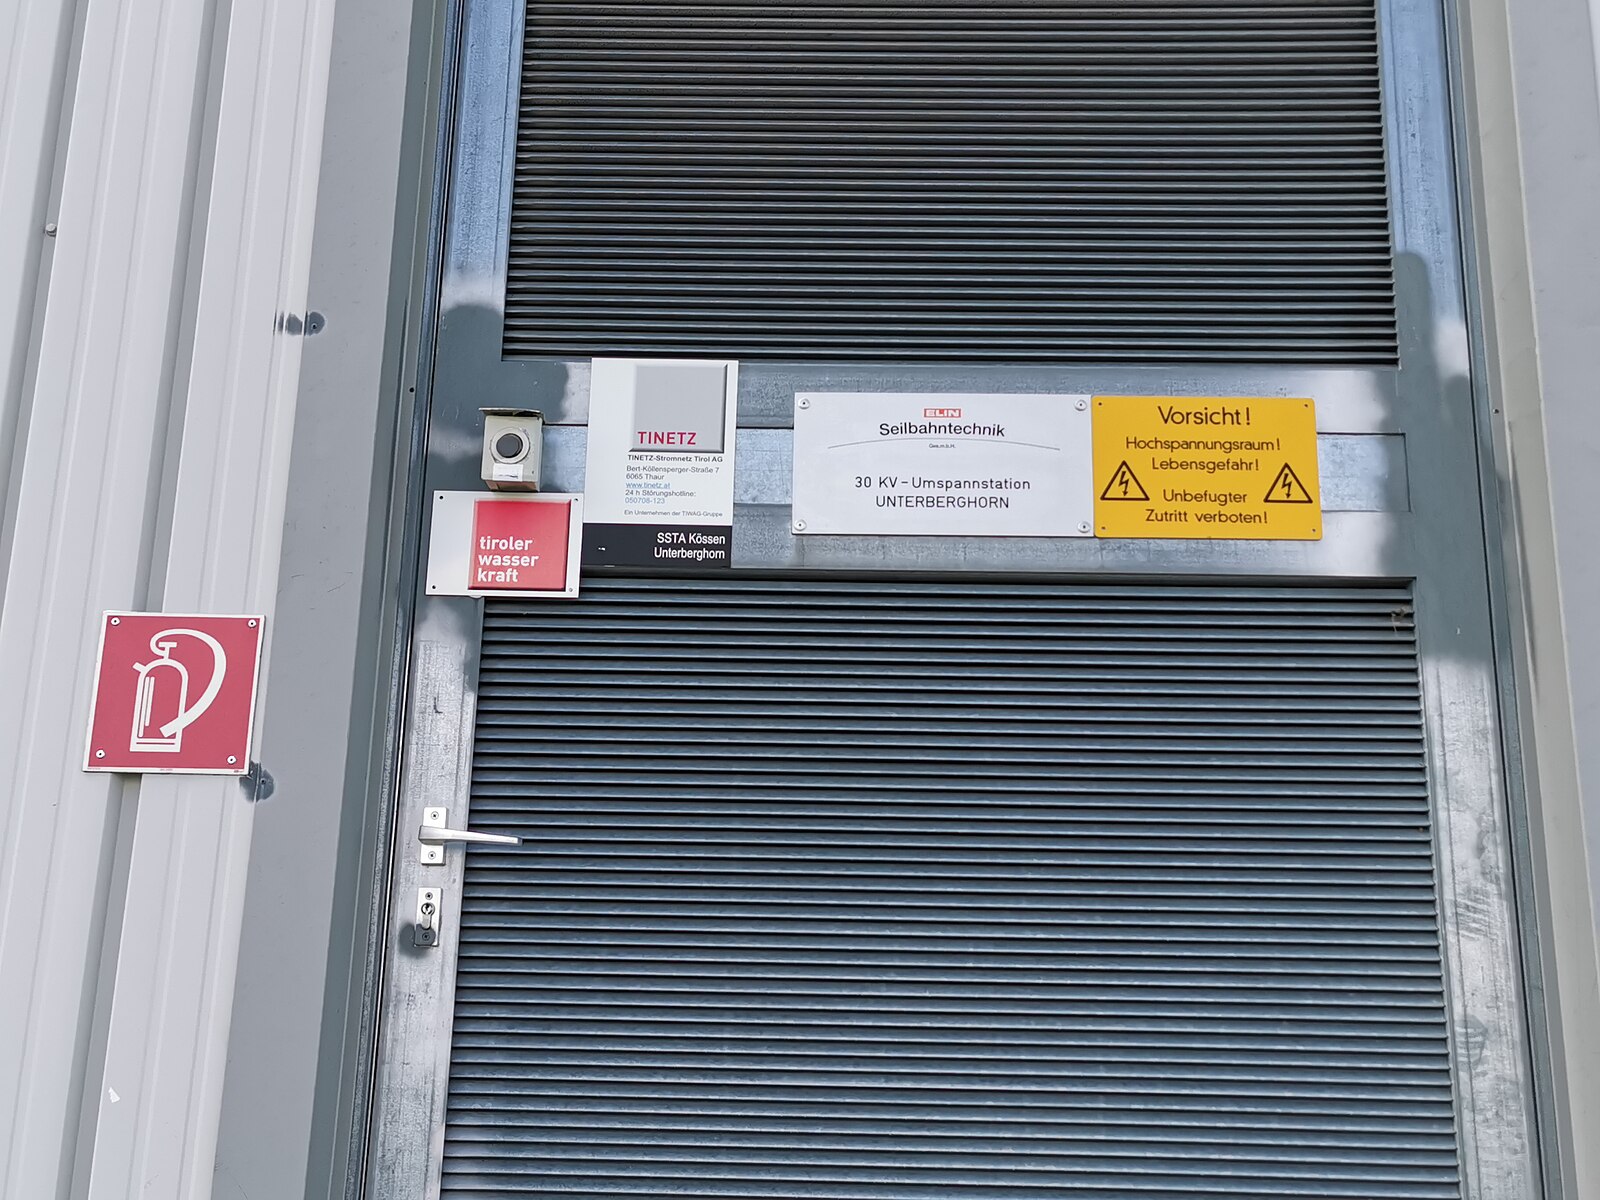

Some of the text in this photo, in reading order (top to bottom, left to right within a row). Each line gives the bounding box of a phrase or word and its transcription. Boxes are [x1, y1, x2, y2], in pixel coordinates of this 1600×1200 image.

[924, 408, 961, 418] ELIN
[879, 422, 1005, 437] Seilbahntechnik
[637, 431, 697, 445] TINETZ
[1126, 437, 1281, 454] Hochspannungsraum!
[627, 454, 693, 462] TINETZ-Stromnetz
[1152, 457, 1260, 474] Lebensgefahr!
[625, 481, 671, 489] www.tinetz.at
[855, 476, 872, 488] 30
[625, 489, 696, 498] 24 h Störungshotline:
[1163, 489, 1248, 506] Unbefugter
[876, 495, 1009, 509] UNTERBERGHORN
[681, 510, 723, 518] TIWAG-Gruppe
[1145, 509, 1268, 524] Zutritt verboten!
[479, 536, 533, 551] tiroler
[656, 532, 726, 545] SSTA Kössen
[478, 554, 539, 567] wasser
[653, 547, 725, 561] Unterberghorn
[477, 568, 519, 582] kraft
